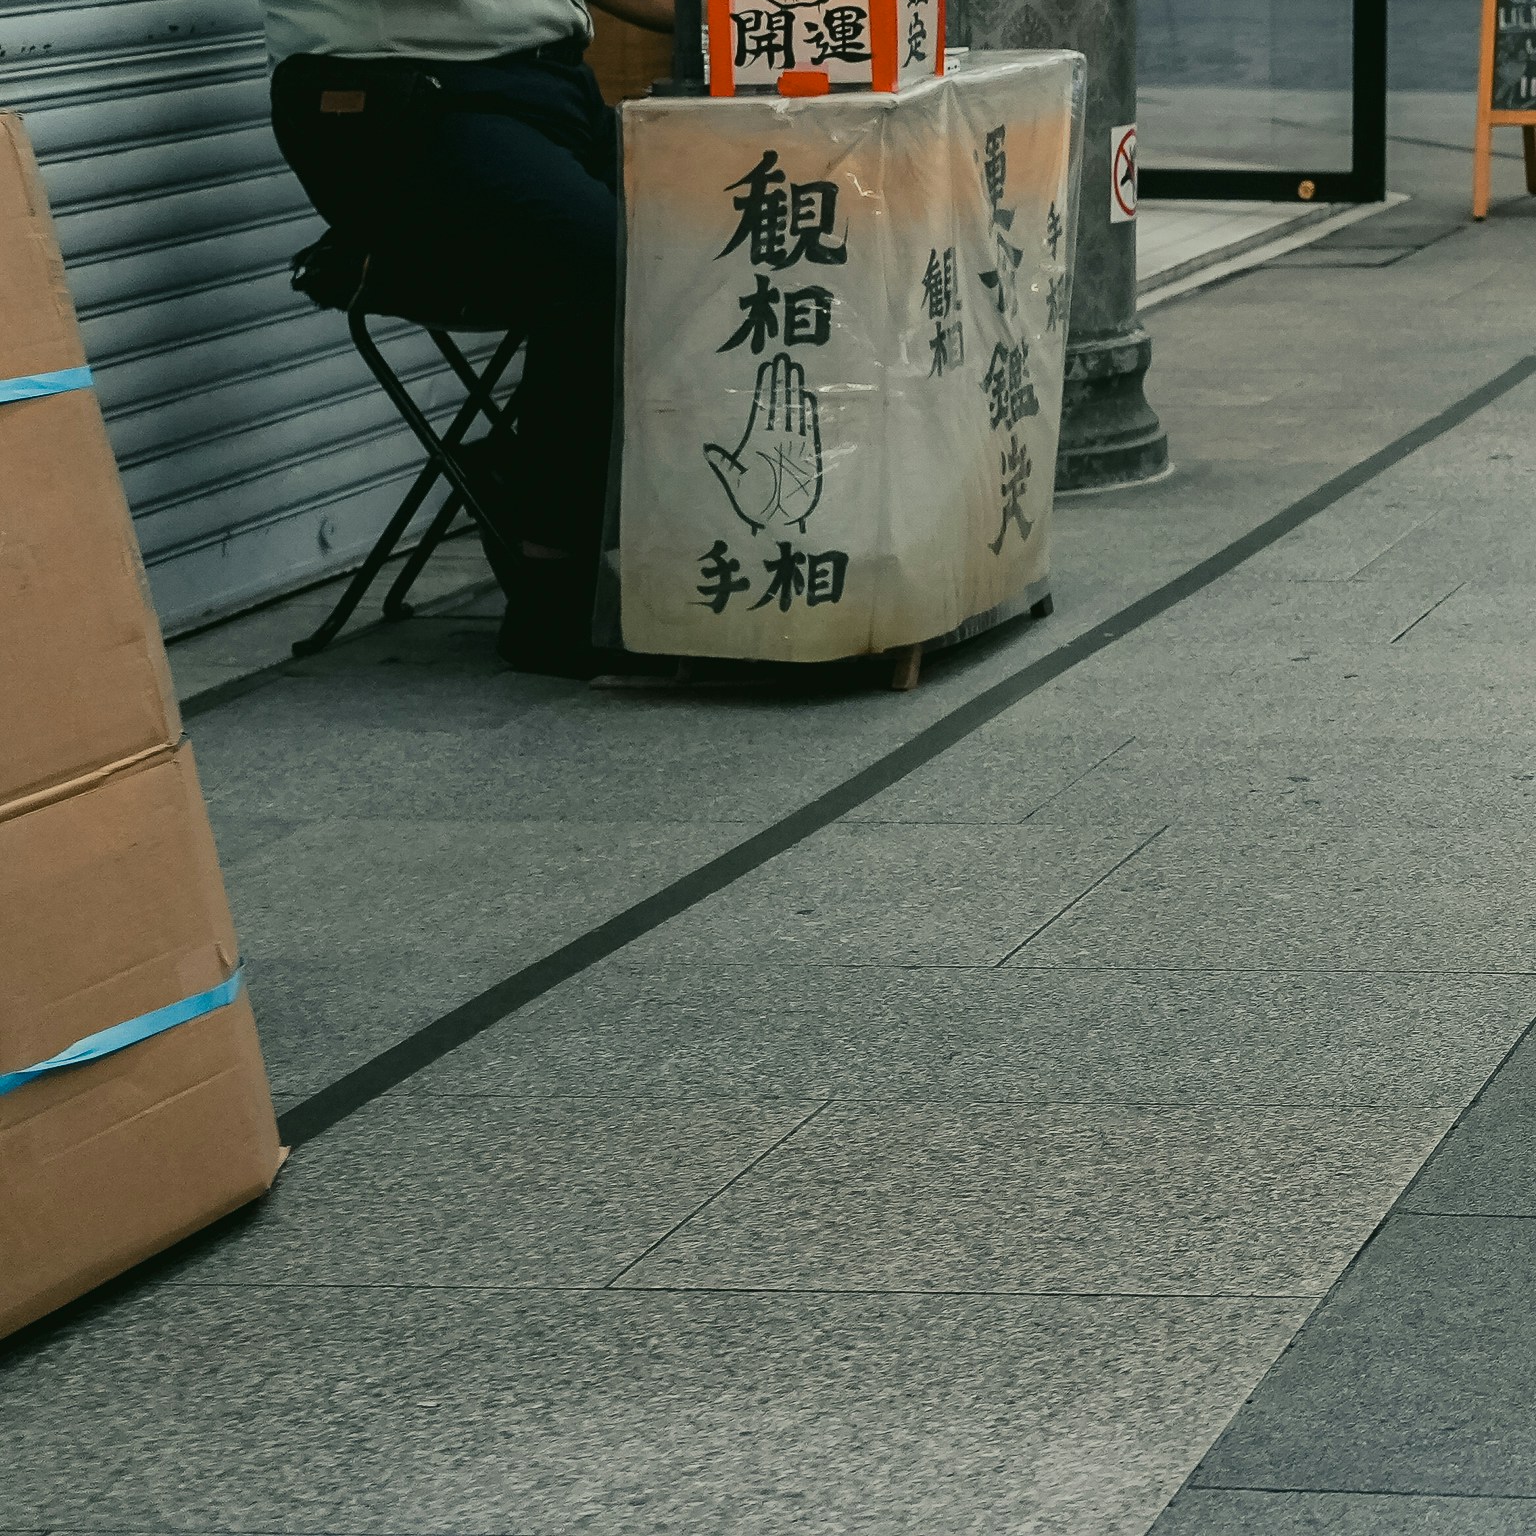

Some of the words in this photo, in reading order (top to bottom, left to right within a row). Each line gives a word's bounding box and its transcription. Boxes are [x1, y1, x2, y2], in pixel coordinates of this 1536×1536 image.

[730, 5, 873, 70] 開運
[712, 149, 849, 356] 観相
[685, 539, 850, 614] 手相
